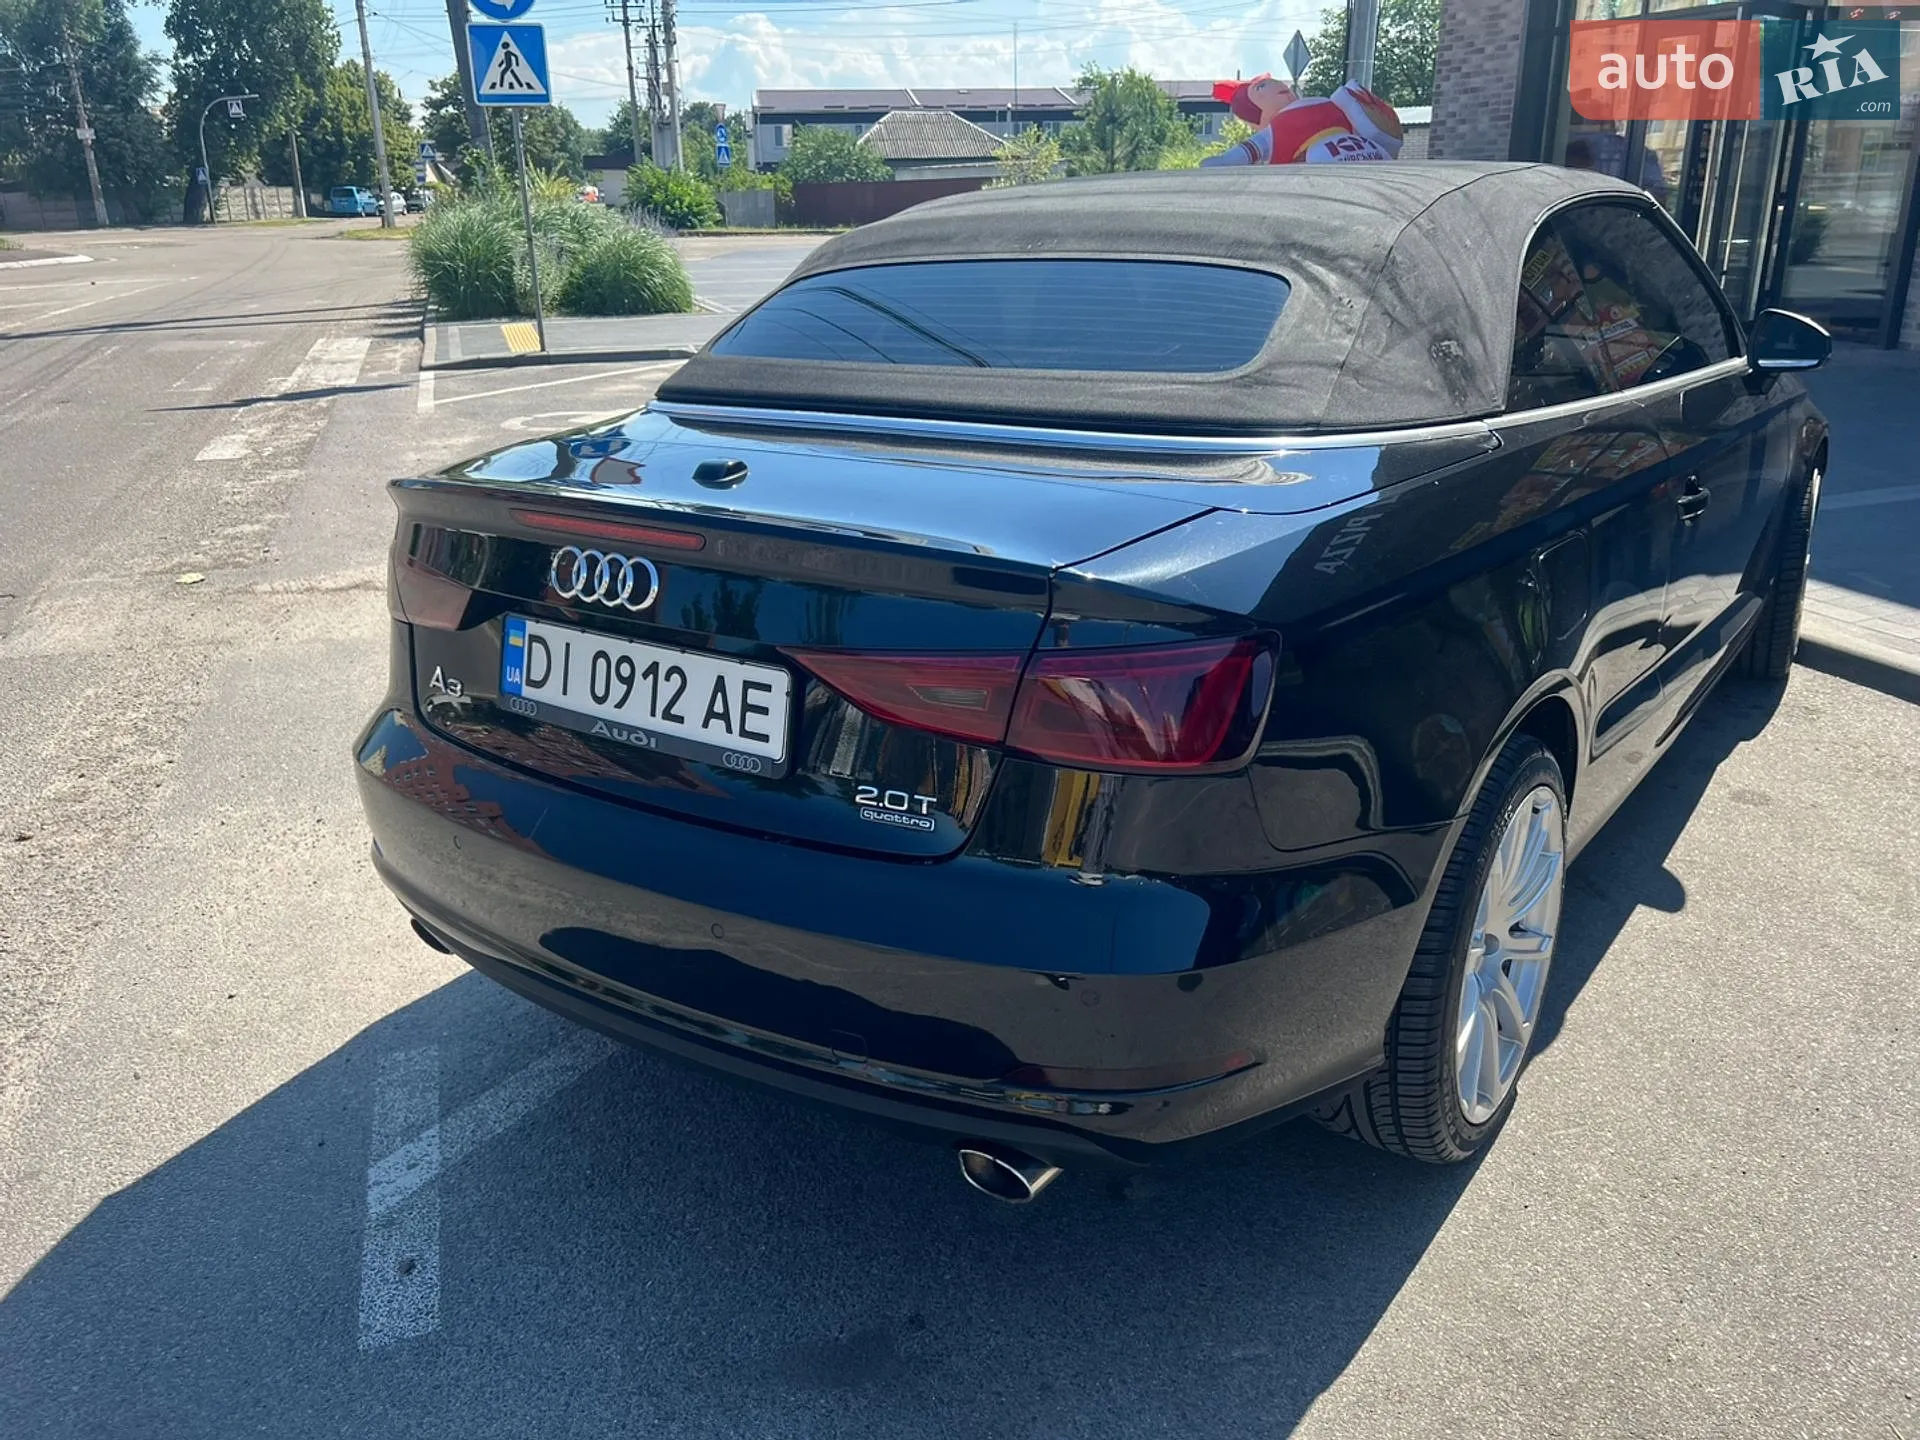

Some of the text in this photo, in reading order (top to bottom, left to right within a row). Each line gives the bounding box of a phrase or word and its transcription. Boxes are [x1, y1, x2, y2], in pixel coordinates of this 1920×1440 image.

[429, 666, 462, 697] A3
[506, 665, 521, 685] UA
[525, 634, 772, 744] DI 0912 AE
[591, 720, 657, 749] Audi
[863, 810, 931, 828] quattro
